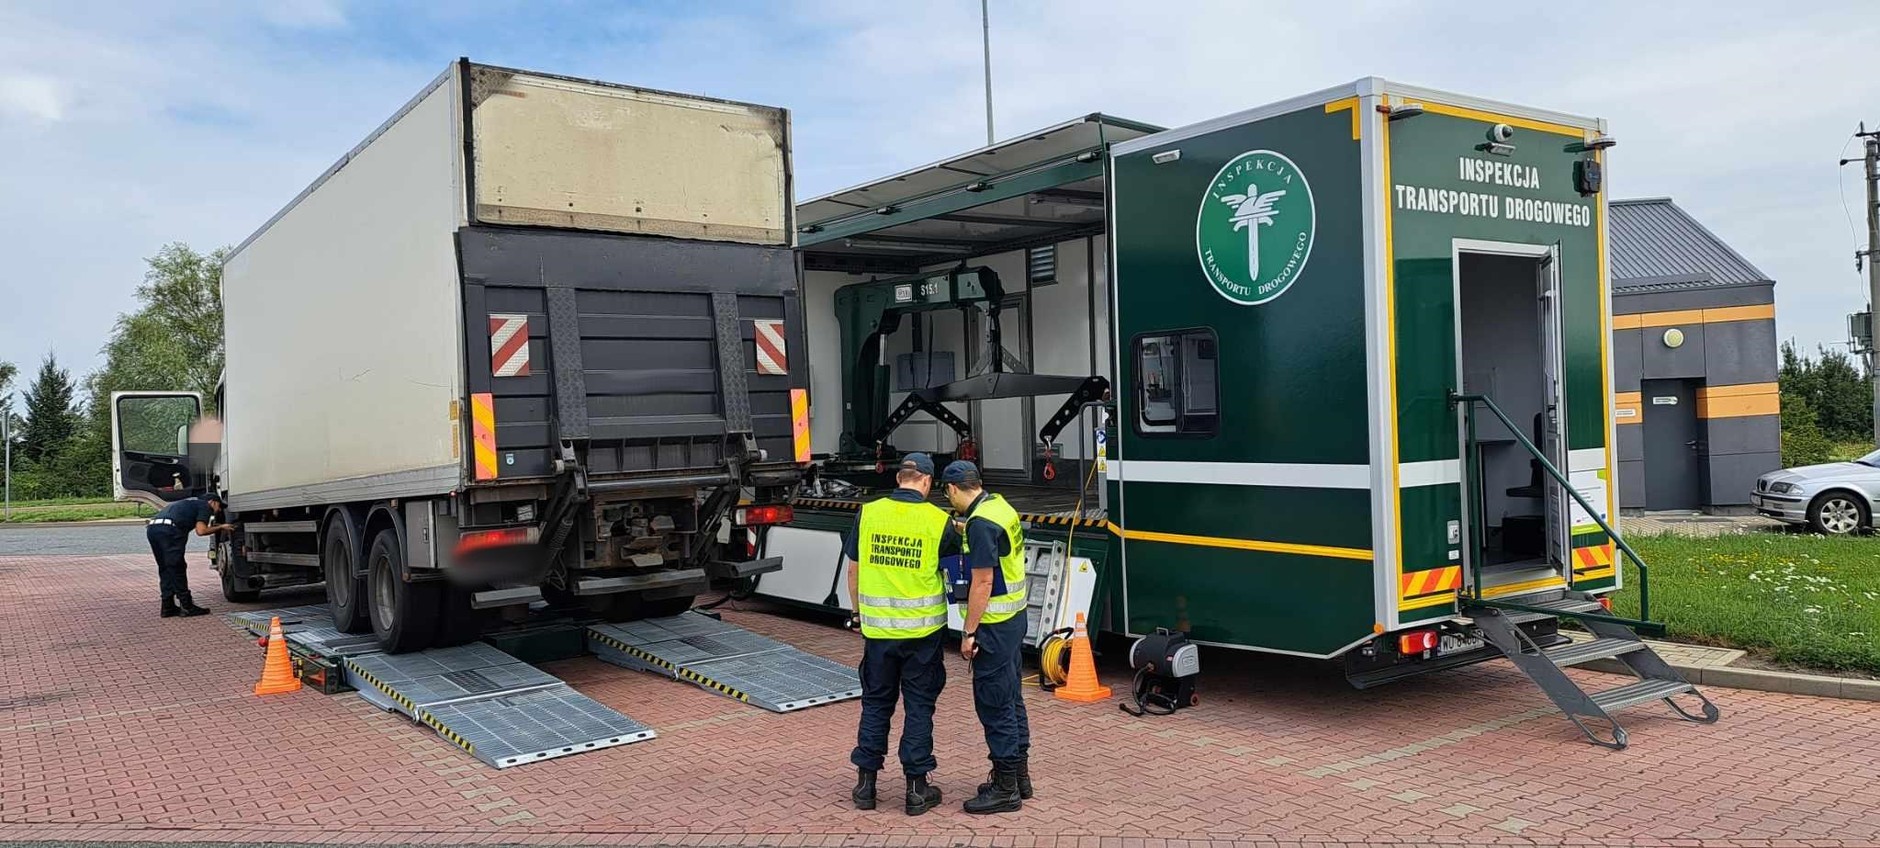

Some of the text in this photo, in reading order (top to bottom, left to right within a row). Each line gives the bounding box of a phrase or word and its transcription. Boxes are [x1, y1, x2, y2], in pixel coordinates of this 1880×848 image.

[1213, 159, 1293, 199] INSPEKCJA
[1459, 156, 1540, 190] INSPEKCJA
[1395, 184, 1590, 227] TRANSPORTU DROGOWEGO
[1204, 231, 1307, 296] TRANSPORTU DROGOWEGO
[871, 533, 923, 548] INSPEKCJA
[871, 543, 922, 558] TRANSPORTU
[869, 554, 921, 569] DROGOWEGO
